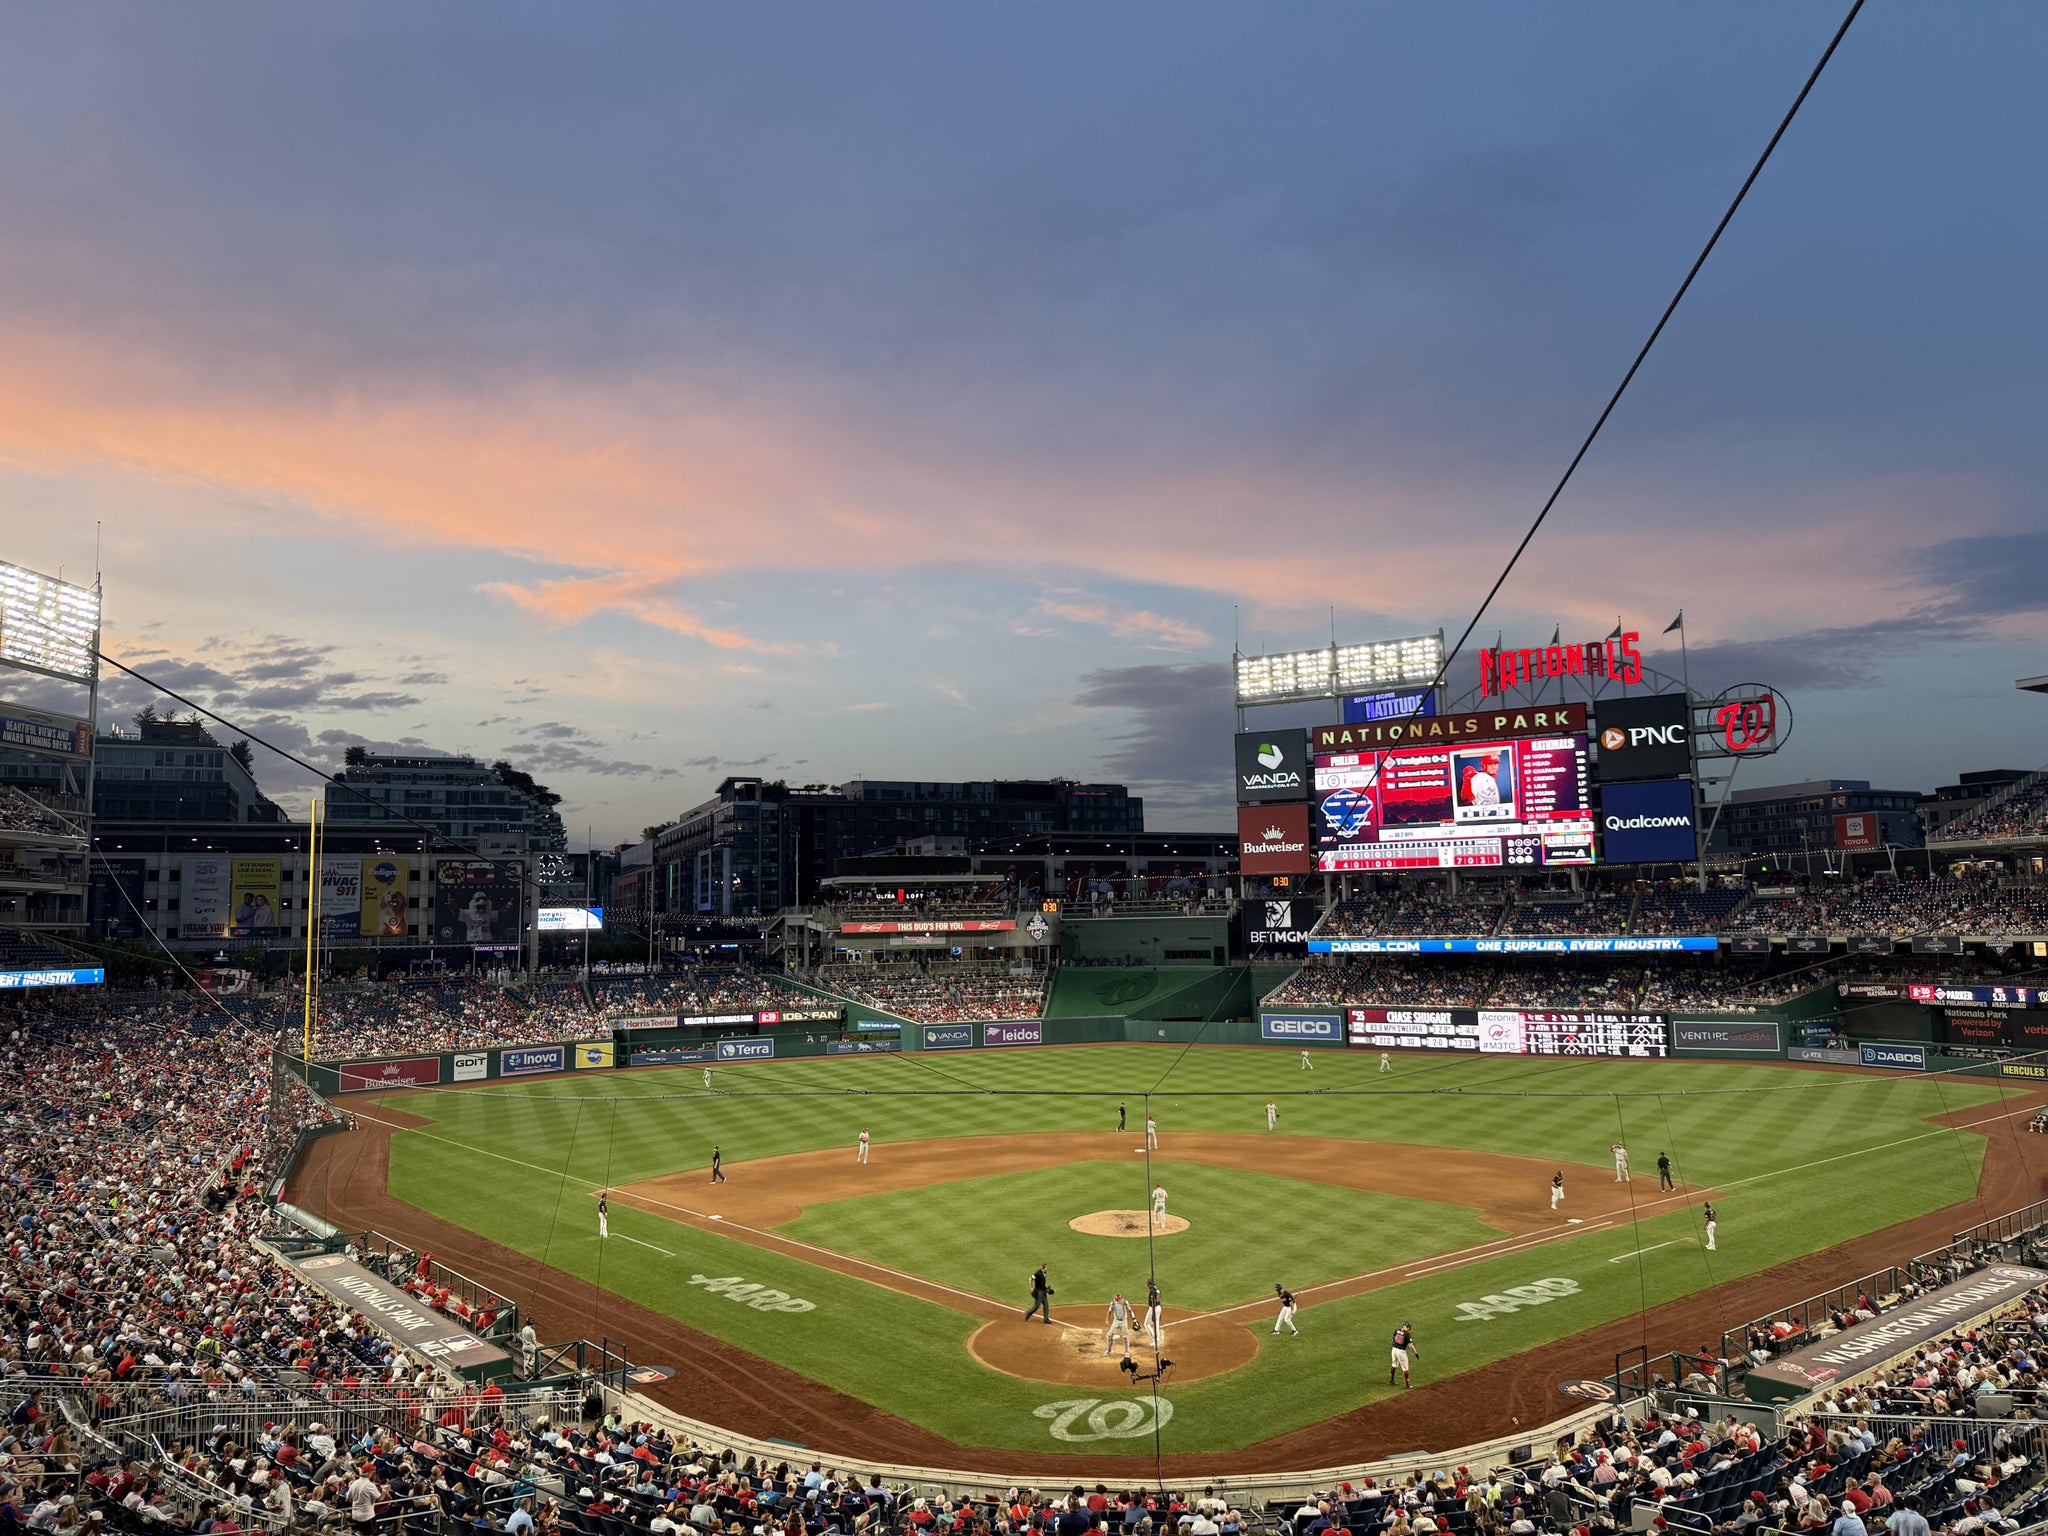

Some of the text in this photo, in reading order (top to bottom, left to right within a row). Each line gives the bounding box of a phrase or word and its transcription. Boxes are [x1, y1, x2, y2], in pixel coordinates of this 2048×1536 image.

[1480, 631, 1641, 697] NATIONALS
[1354, 692, 1395, 704] SHOW SOME
[1366, 694, 1424, 718] NATITUDE
[1322, 710, 1569, 745] NATIONALS PARK
[1628, 724, 1685, 747] PNC
[1243, 772, 1301, 786] VANDA
[1605, 815, 1691, 831] Qualcomm
[1243, 842, 1304, 854] Budweiser
[1844, 838, 1869, 846] TOYOTA
[322, 876, 358, 886] HVAC
[336, 886, 357, 896] 911
[1042, 902, 1058, 912] 0:30
[897, 923, 913, 931] THIS
[914, 922, 934, 931] BUD'S
[935, 922, 949, 930] FOR
[1250, 931, 1308, 943] BETMGM
[1330, 942, 1420, 952] DABOS.COM
[1475, 942, 1502, 951] ONE
[1569, 941, 1612, 951] EVERY
[1614, 939, 1683, 950] INDUSTRY.
[23, 972, 76, 985] INDUSTRY.
[1946, 990, 1973, 1000] PARKER
[1386, 1011, 1413, 1023] CHASE
[1413, 1012, 1452, 1024] SHUGART
[1481, 1013, 1516, 1022] Acronis
[1944, 1009, 2008, 1019] Nationals Park
[626, 1018, 676, 1028] Harris Teeter
[1270, 1020, 1331, 1034] GEICO
[1951, 1018, 2002, 1029] powered by
[936, 1031, 968, 1040] VANDA
[1002, 1029, 1039, 1041] leidos
[1680, 1031, 1771, 1042] VENTURE GLOBAL
[1961, 1028, 1994, 1037] Verizon
[736, 1043, 769, 1054] Terra
[1483, 1042, 1516, 1050] #M3TC
[456, 1059, 487, 1067] GDIT
[524, 1053, 557, 1065] Inova
[1877, 1052, 1922, 1063] DABOS
[2003, 1066, 2045, 1078] HERCULES
[365, 1075, 416, 1089] Budweiser
[688, 1272, 816, 1314] AARP
[1453, 1276, 1583, 1322] AARP
[334, 1274, 436, 1331] NATIONALS PARK
[1812, 1277, 2018, 1365] WASHINGTON NATIONALS
